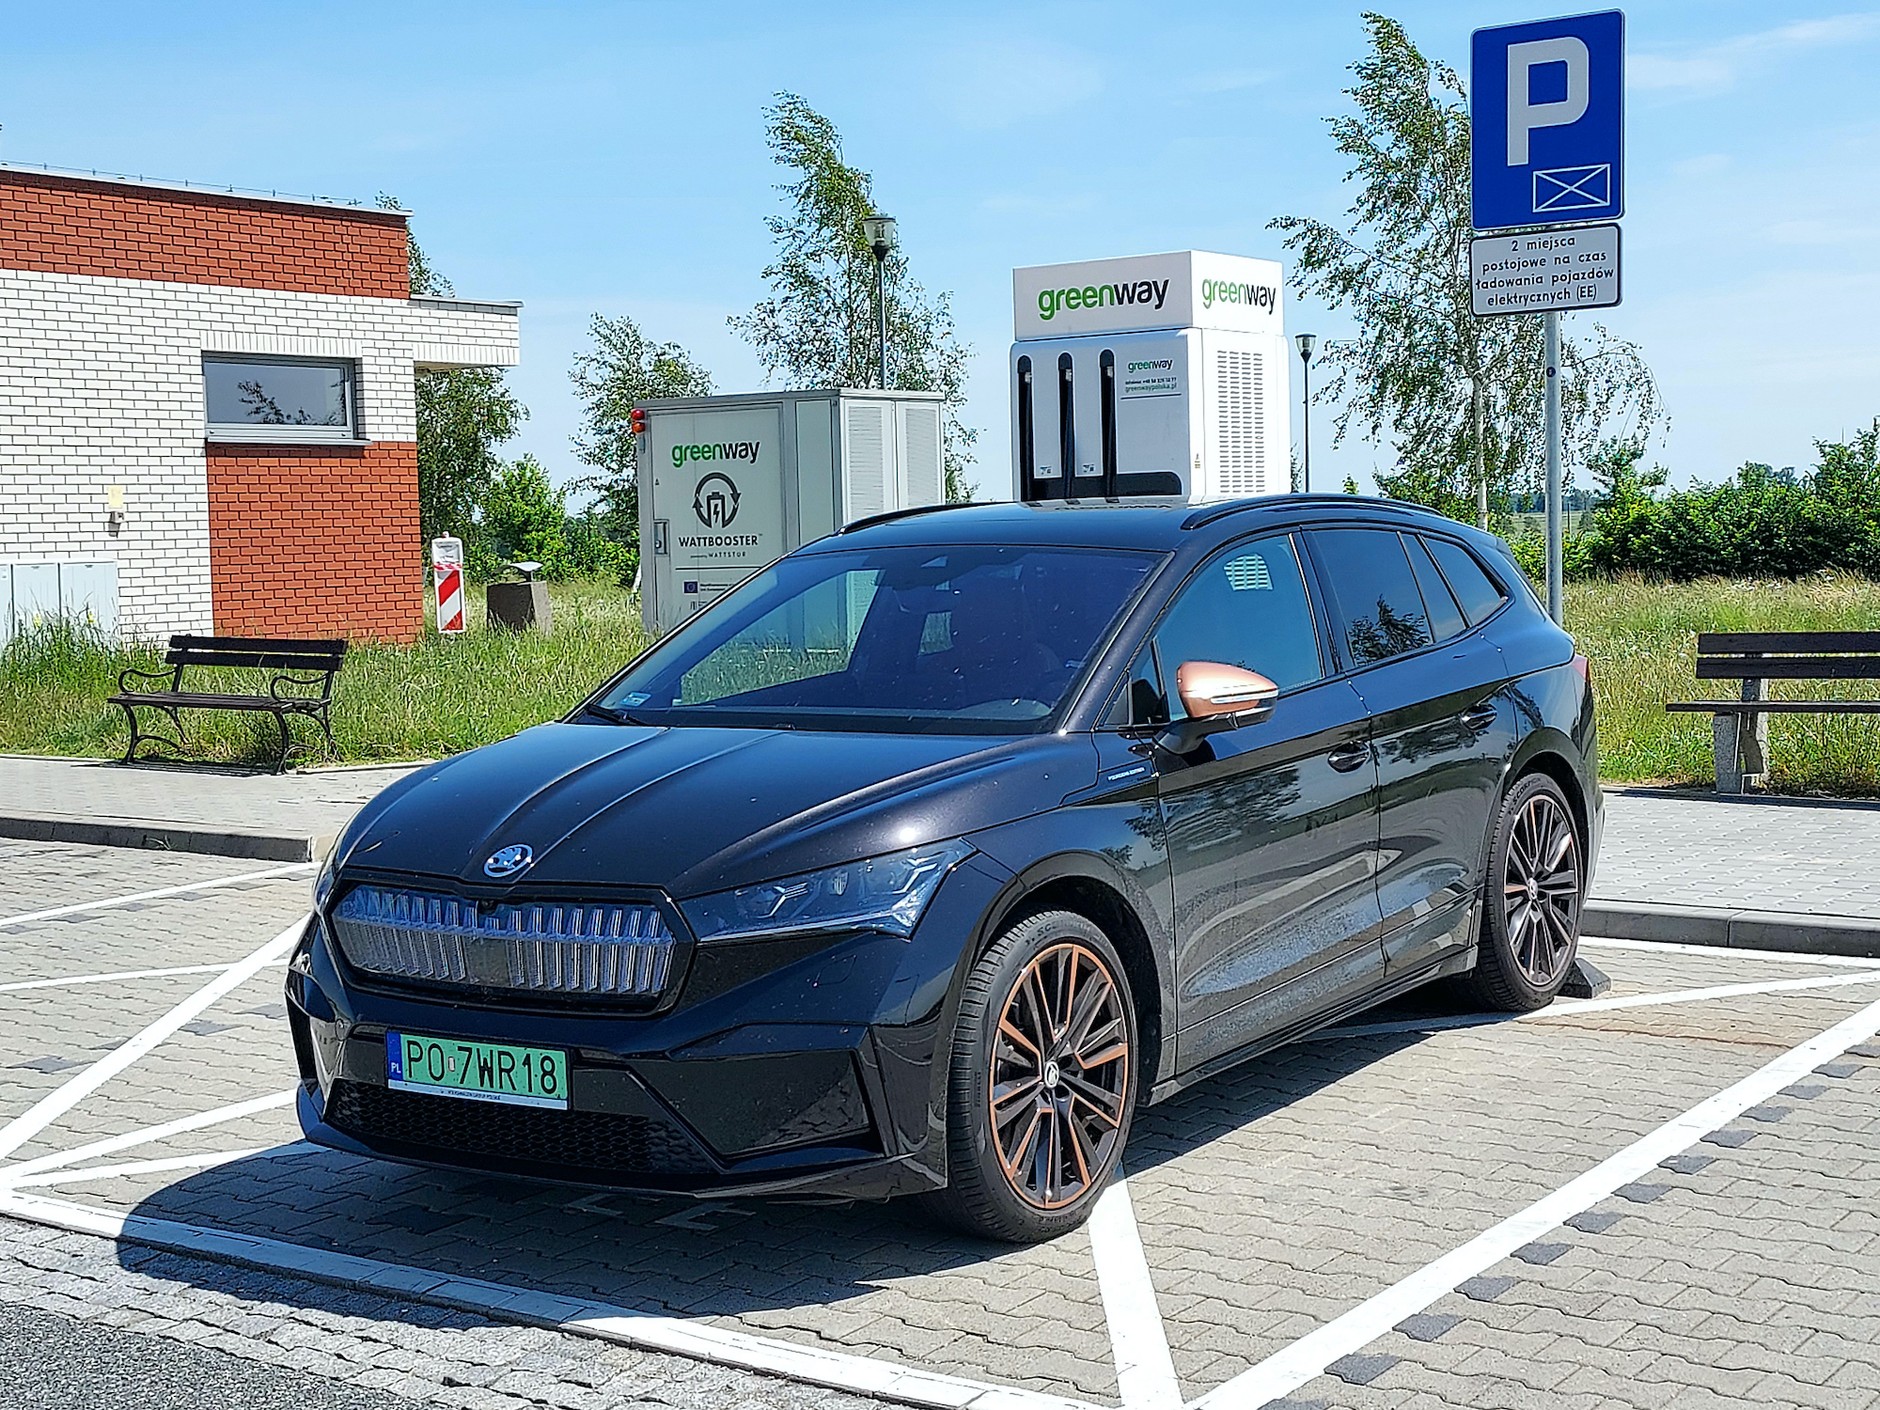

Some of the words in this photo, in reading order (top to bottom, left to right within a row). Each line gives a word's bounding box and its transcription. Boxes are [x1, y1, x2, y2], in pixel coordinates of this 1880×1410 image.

[1507, 36, 1589, 166] P
[1511, 240, 1519, 252] 2
[1527, 236, 1576, 251] miejsca
[1482, 257, 1547, 275] postojowe
[1554, 255, 1570, 266] na
[1578, 251, 1607, 263] czas
[1475, 273, 1543, 290] ładowania
[1551, 267, 1614, 286] pojazdów
[1038, 279, 1170, 320] greenway
[1202, 279, 1276, 315] greenway
[1487, 288, 1571, 307] elektrycznych
[1576, 283, 1597, 302] (EE)
[1127, 359, 1173, 374] greenway
[672, 442, 760, 467] greenway
[678, 535, 758, 548] WATTBOOSTER
[391, 1062, 402, 1074] PL
[407, 1040, 445, 1082] PO
[457, 1046, 558, 1095] 7WR18
